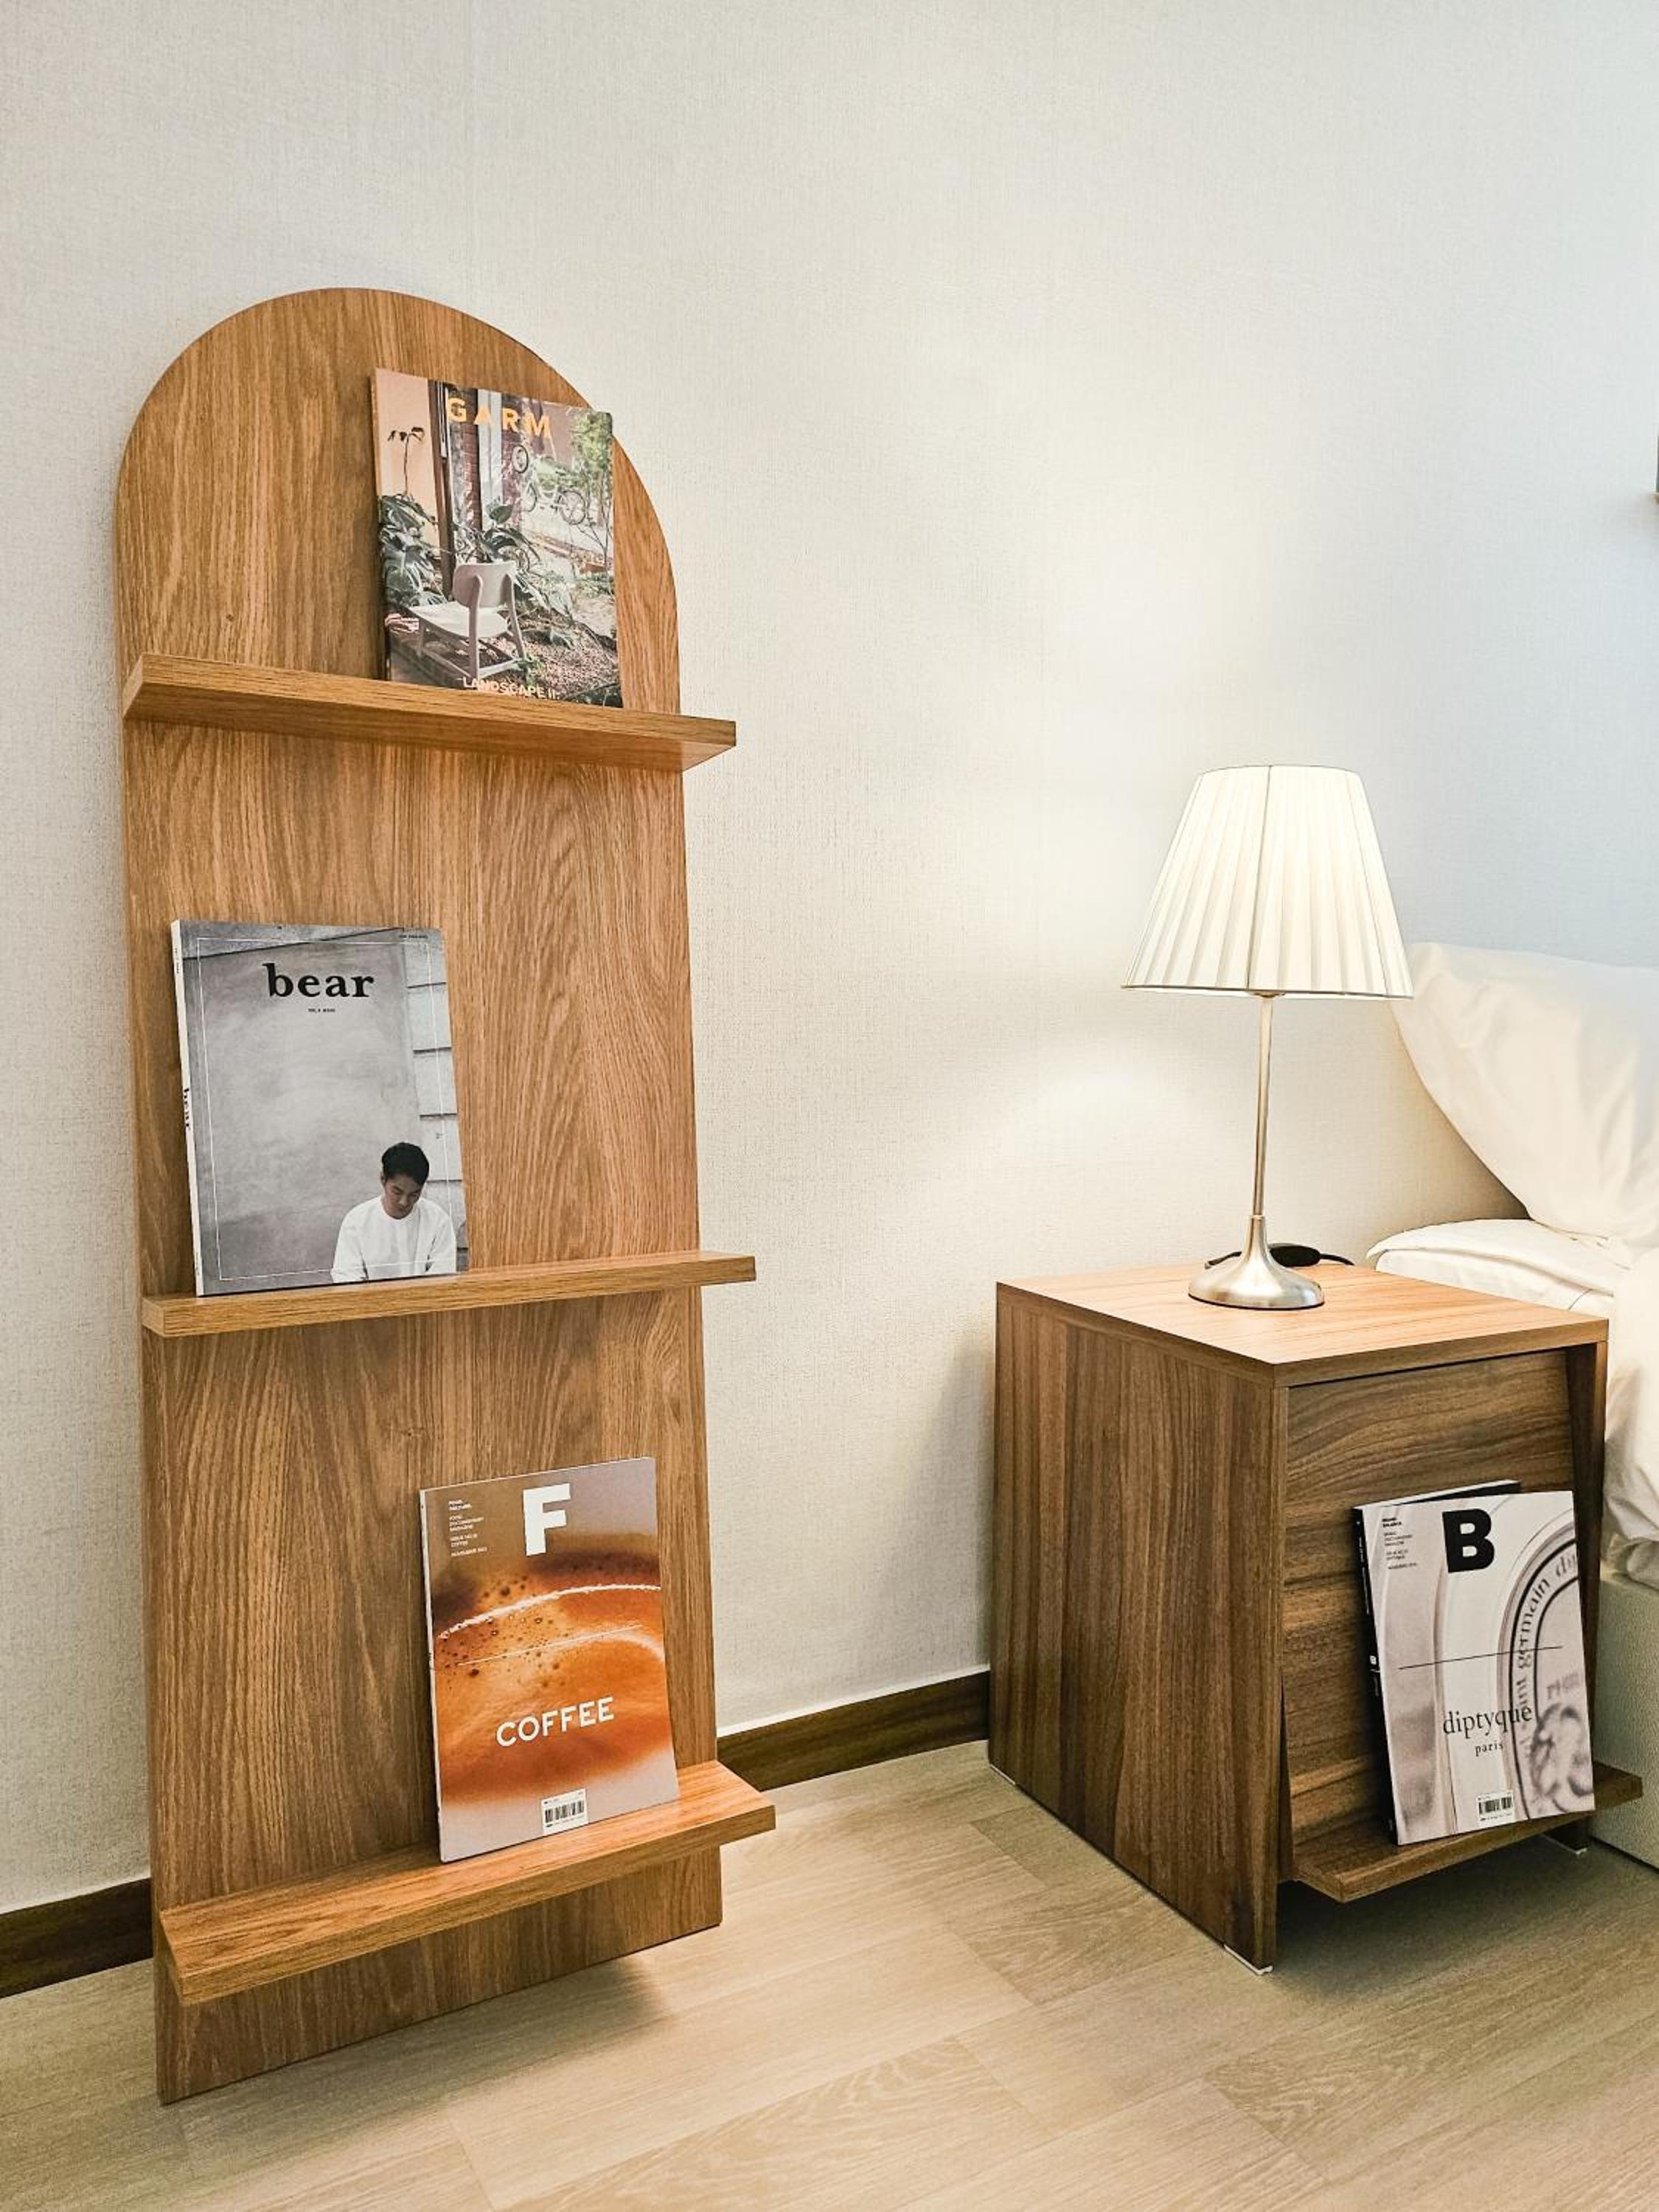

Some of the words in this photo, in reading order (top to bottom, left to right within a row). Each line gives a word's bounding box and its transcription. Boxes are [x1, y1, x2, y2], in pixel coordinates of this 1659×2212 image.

[448, 397, 552, 439] GARM
[462, 676, 544, 699] LANDSCAPE
[262, 962, 375, 998] bear
[523, 1483, 571, 1557] F
[1441, 1508, 1495, 1574] B
[495, 1696, 615, 1747] COFFEE
[1442, 1706, 1533, 1740] diptyque
[1475, 1740, 1504, 1757] paris
